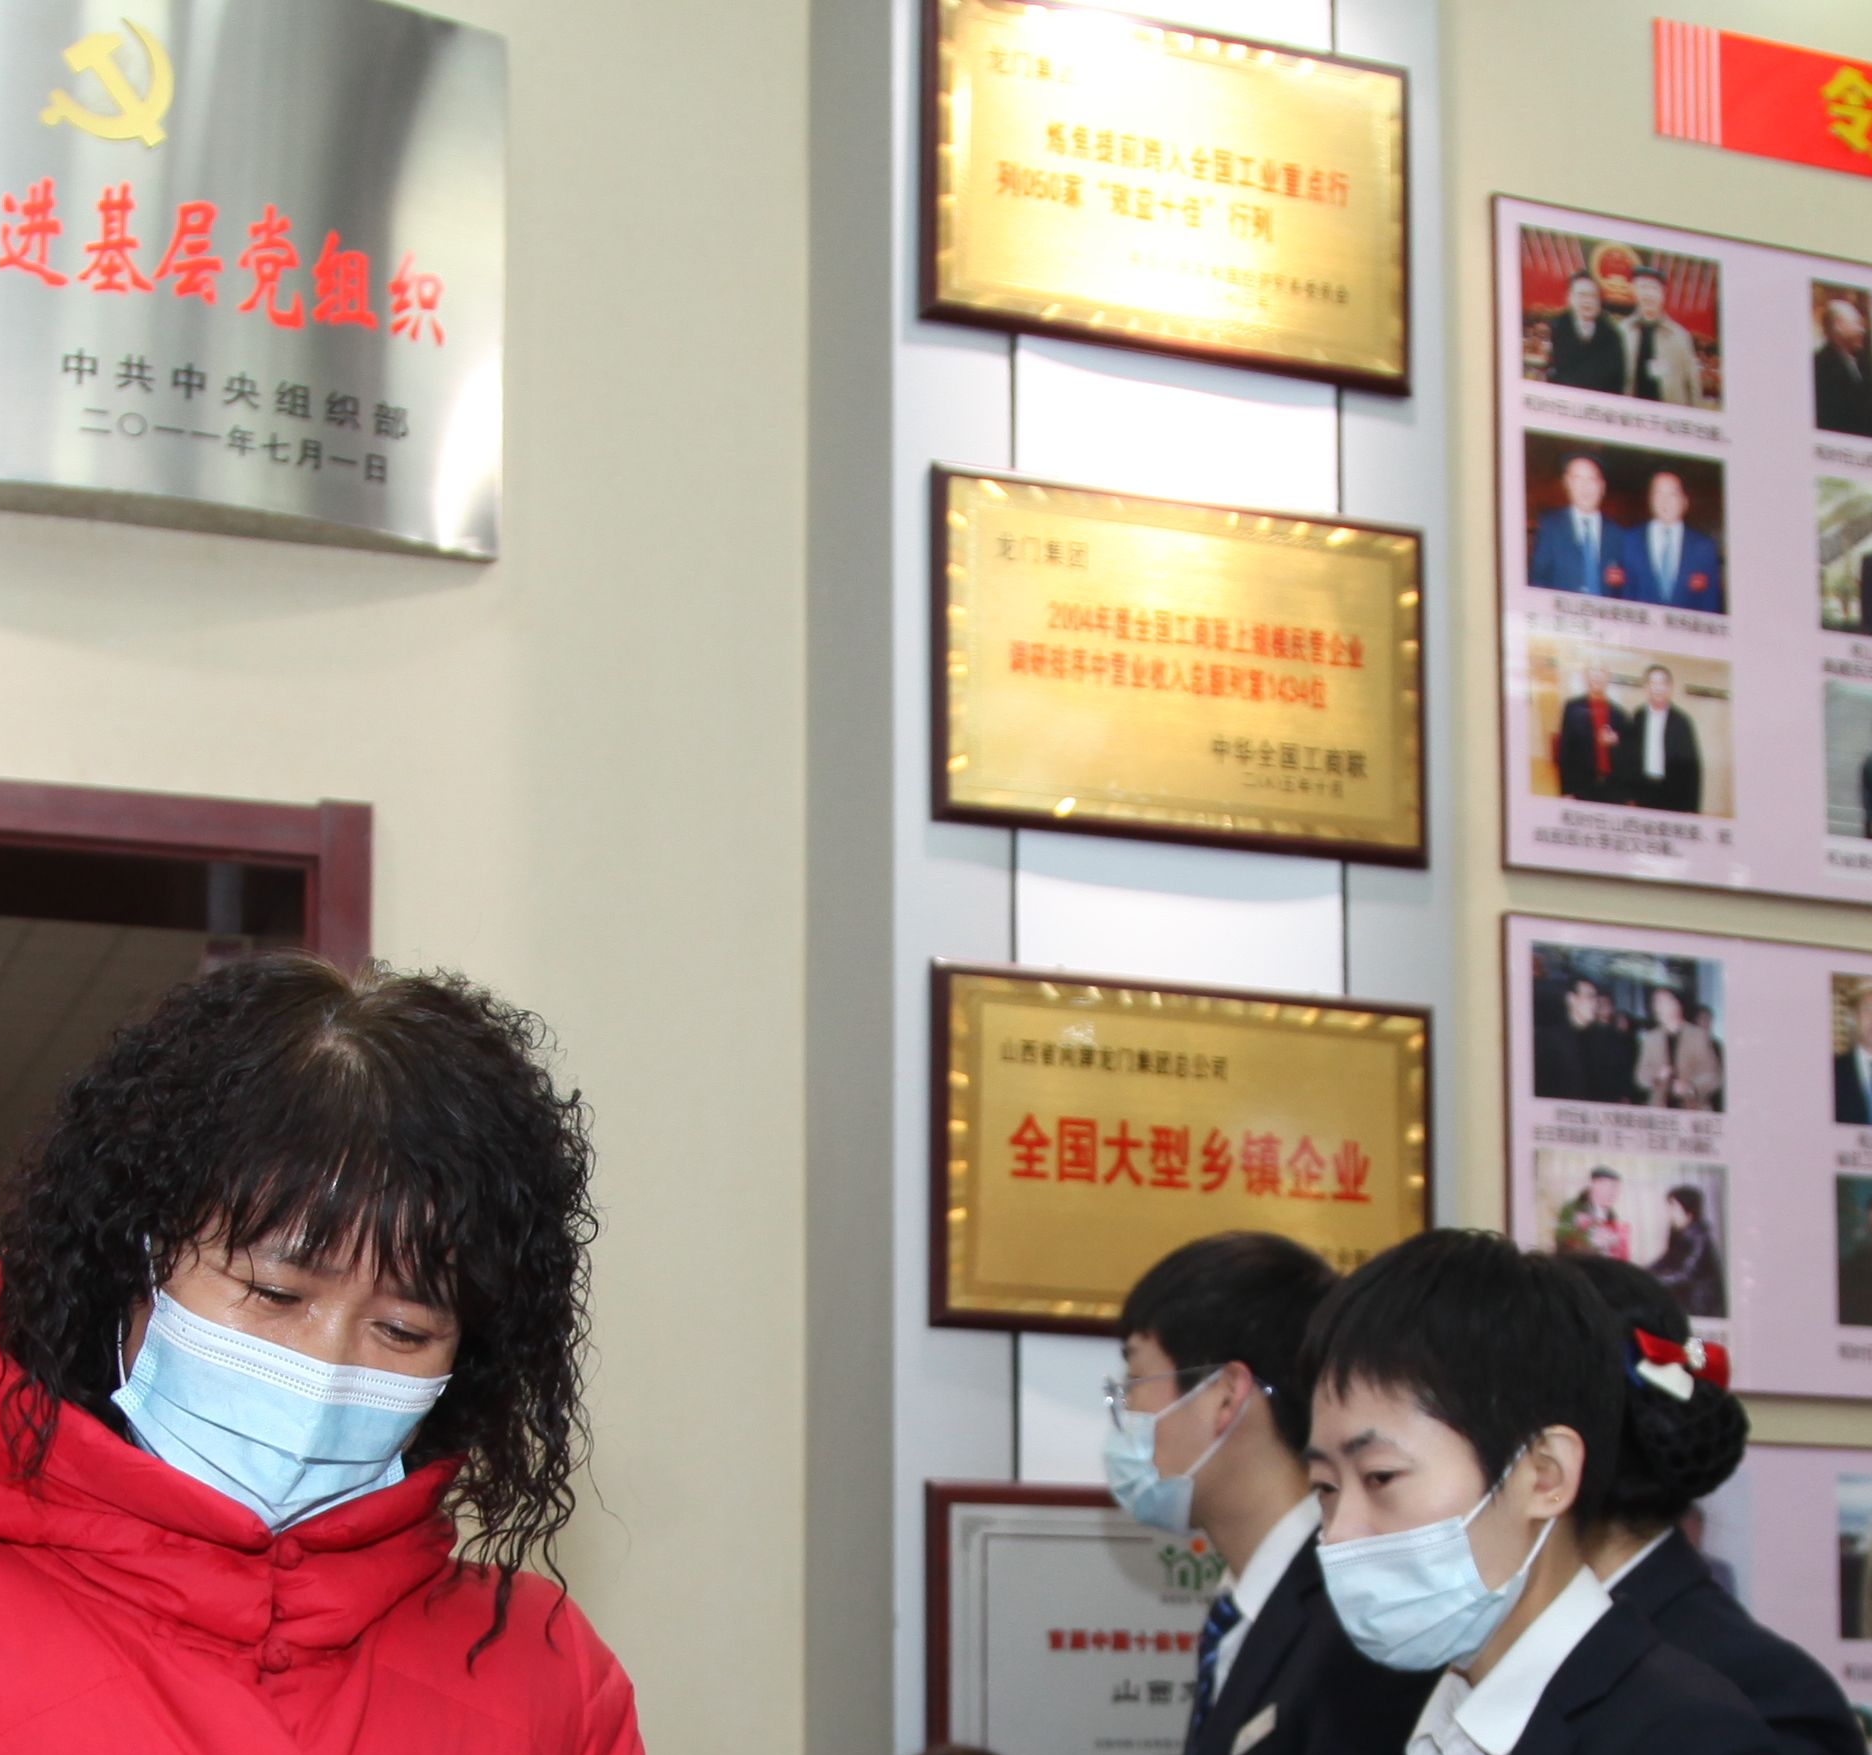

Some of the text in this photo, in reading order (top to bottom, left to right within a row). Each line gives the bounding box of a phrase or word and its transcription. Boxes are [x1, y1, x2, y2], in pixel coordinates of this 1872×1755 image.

[62, 348, 410, 441] 中共中央组织部
[997, 534, 1089, 569] 龙门集团
[1212, 733, 1368, 778] 中华全国工商联
[1009, 1112, 1371, 1204] 全国大型乡镇企业
